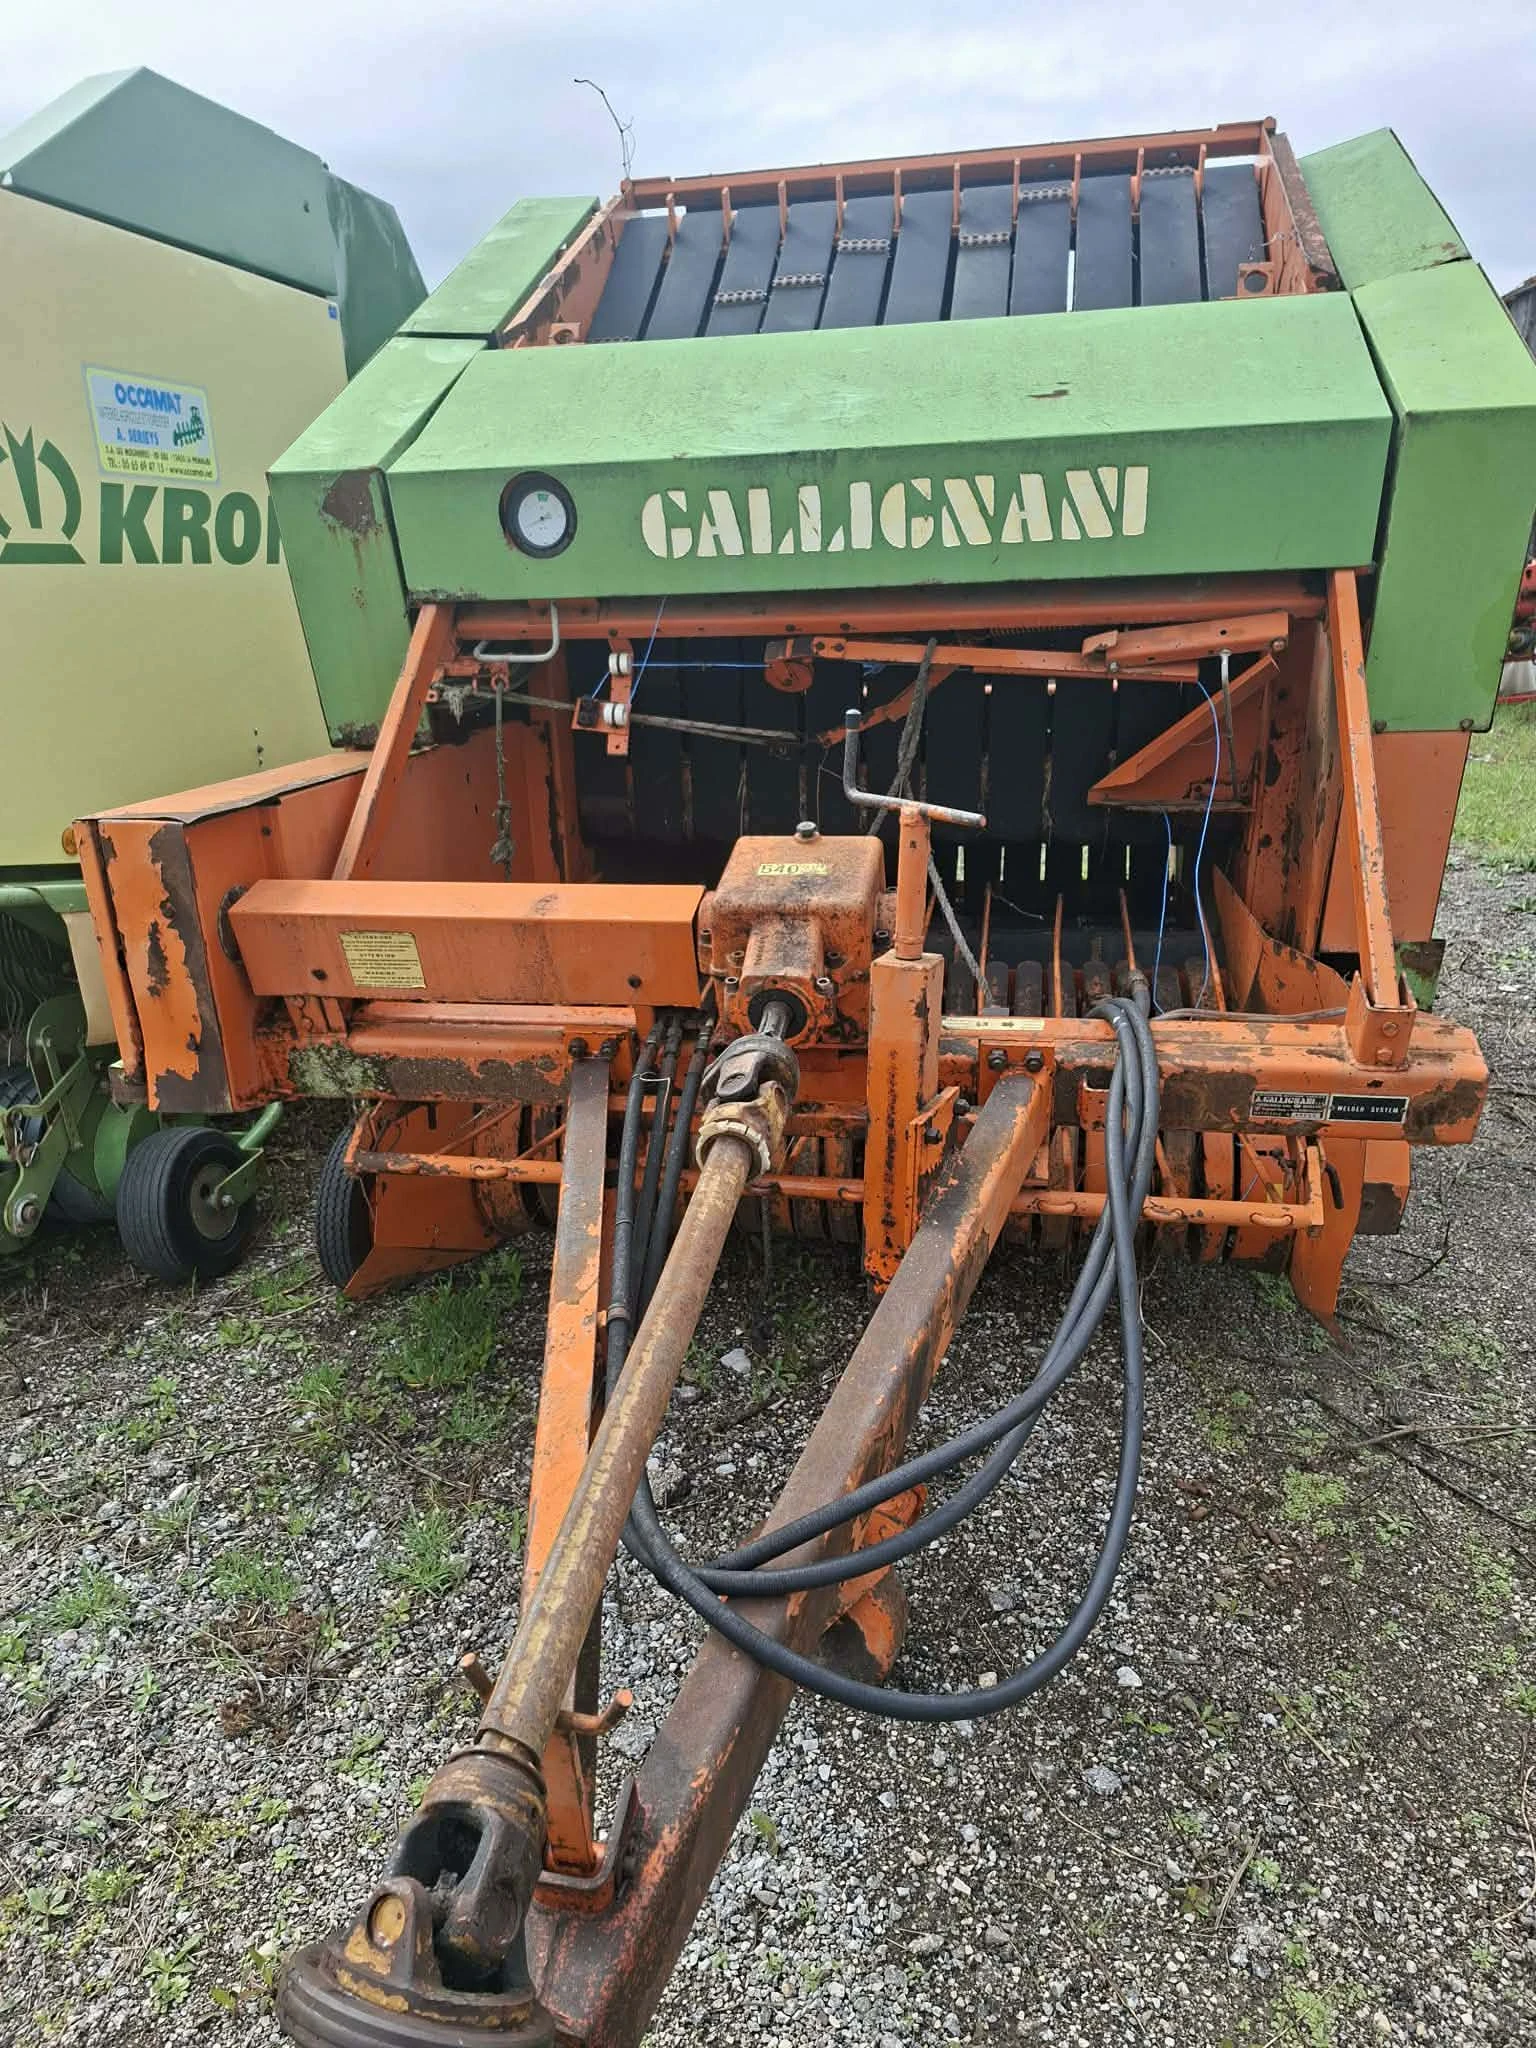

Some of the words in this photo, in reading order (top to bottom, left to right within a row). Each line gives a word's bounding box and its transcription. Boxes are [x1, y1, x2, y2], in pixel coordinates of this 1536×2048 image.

[114, 383, 181, 415] OCCAMAT
[641, 465, 1149, 559] GALLIGNANI
[760, 864, 799, 874] 540
[1370, 1106, 1399, 1114] SYSTEM
